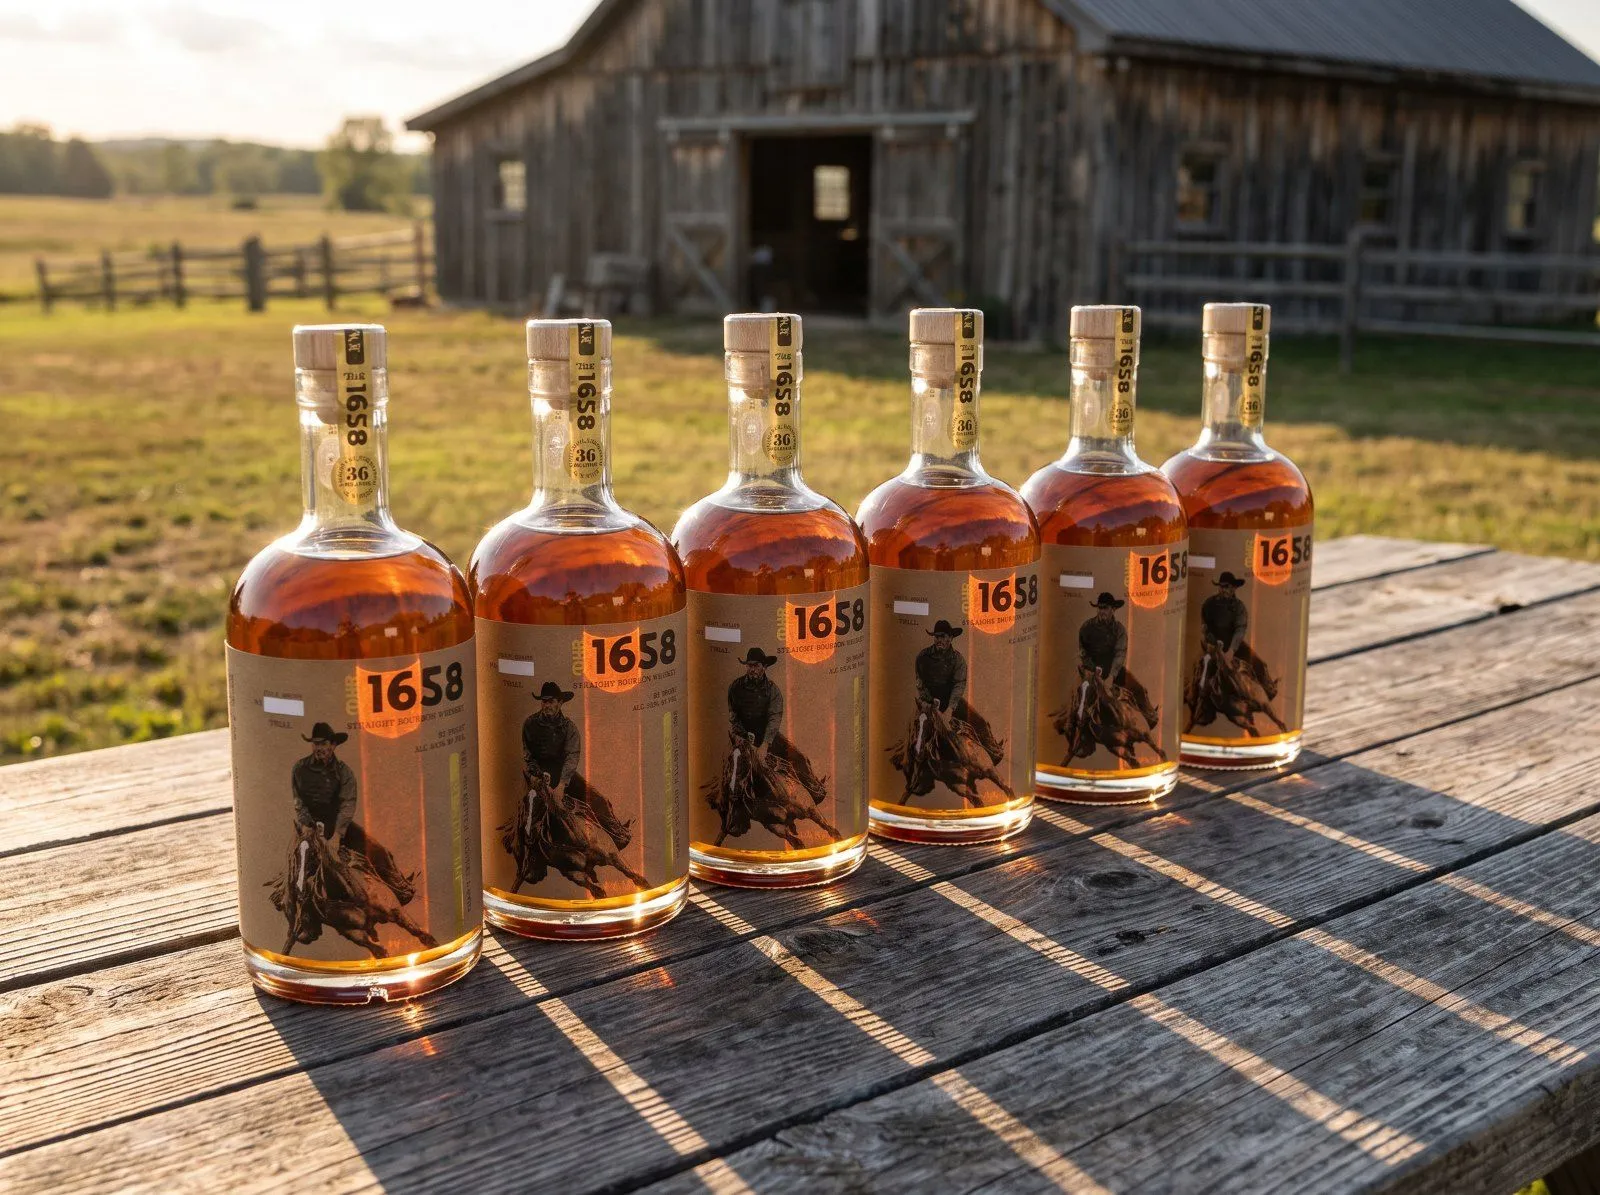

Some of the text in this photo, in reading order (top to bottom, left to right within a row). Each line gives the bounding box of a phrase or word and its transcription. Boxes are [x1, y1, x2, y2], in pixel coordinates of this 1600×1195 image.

[959, 353, 976, 404] 1658
[1118, 347, 1134, 393] 1658
[1248, 344, 1262, 387] 1658
[576, 372, 597, 431] 1658
[774, 362, 793, 417] 1658
[346, 383, 368, 446] 1658
[346, 466, 369, 481] 36
[575, 448, 596, 462] 36
[1139, 550, 1188, 585] 1658
[1260, 534, 1312, 567] 1658
[978, 574, 1038, 613] 1658
[795, 598, 865, 640] 1658
[592, 628, 677, 675] 1658
[367, 661, 464, 714] 1658
